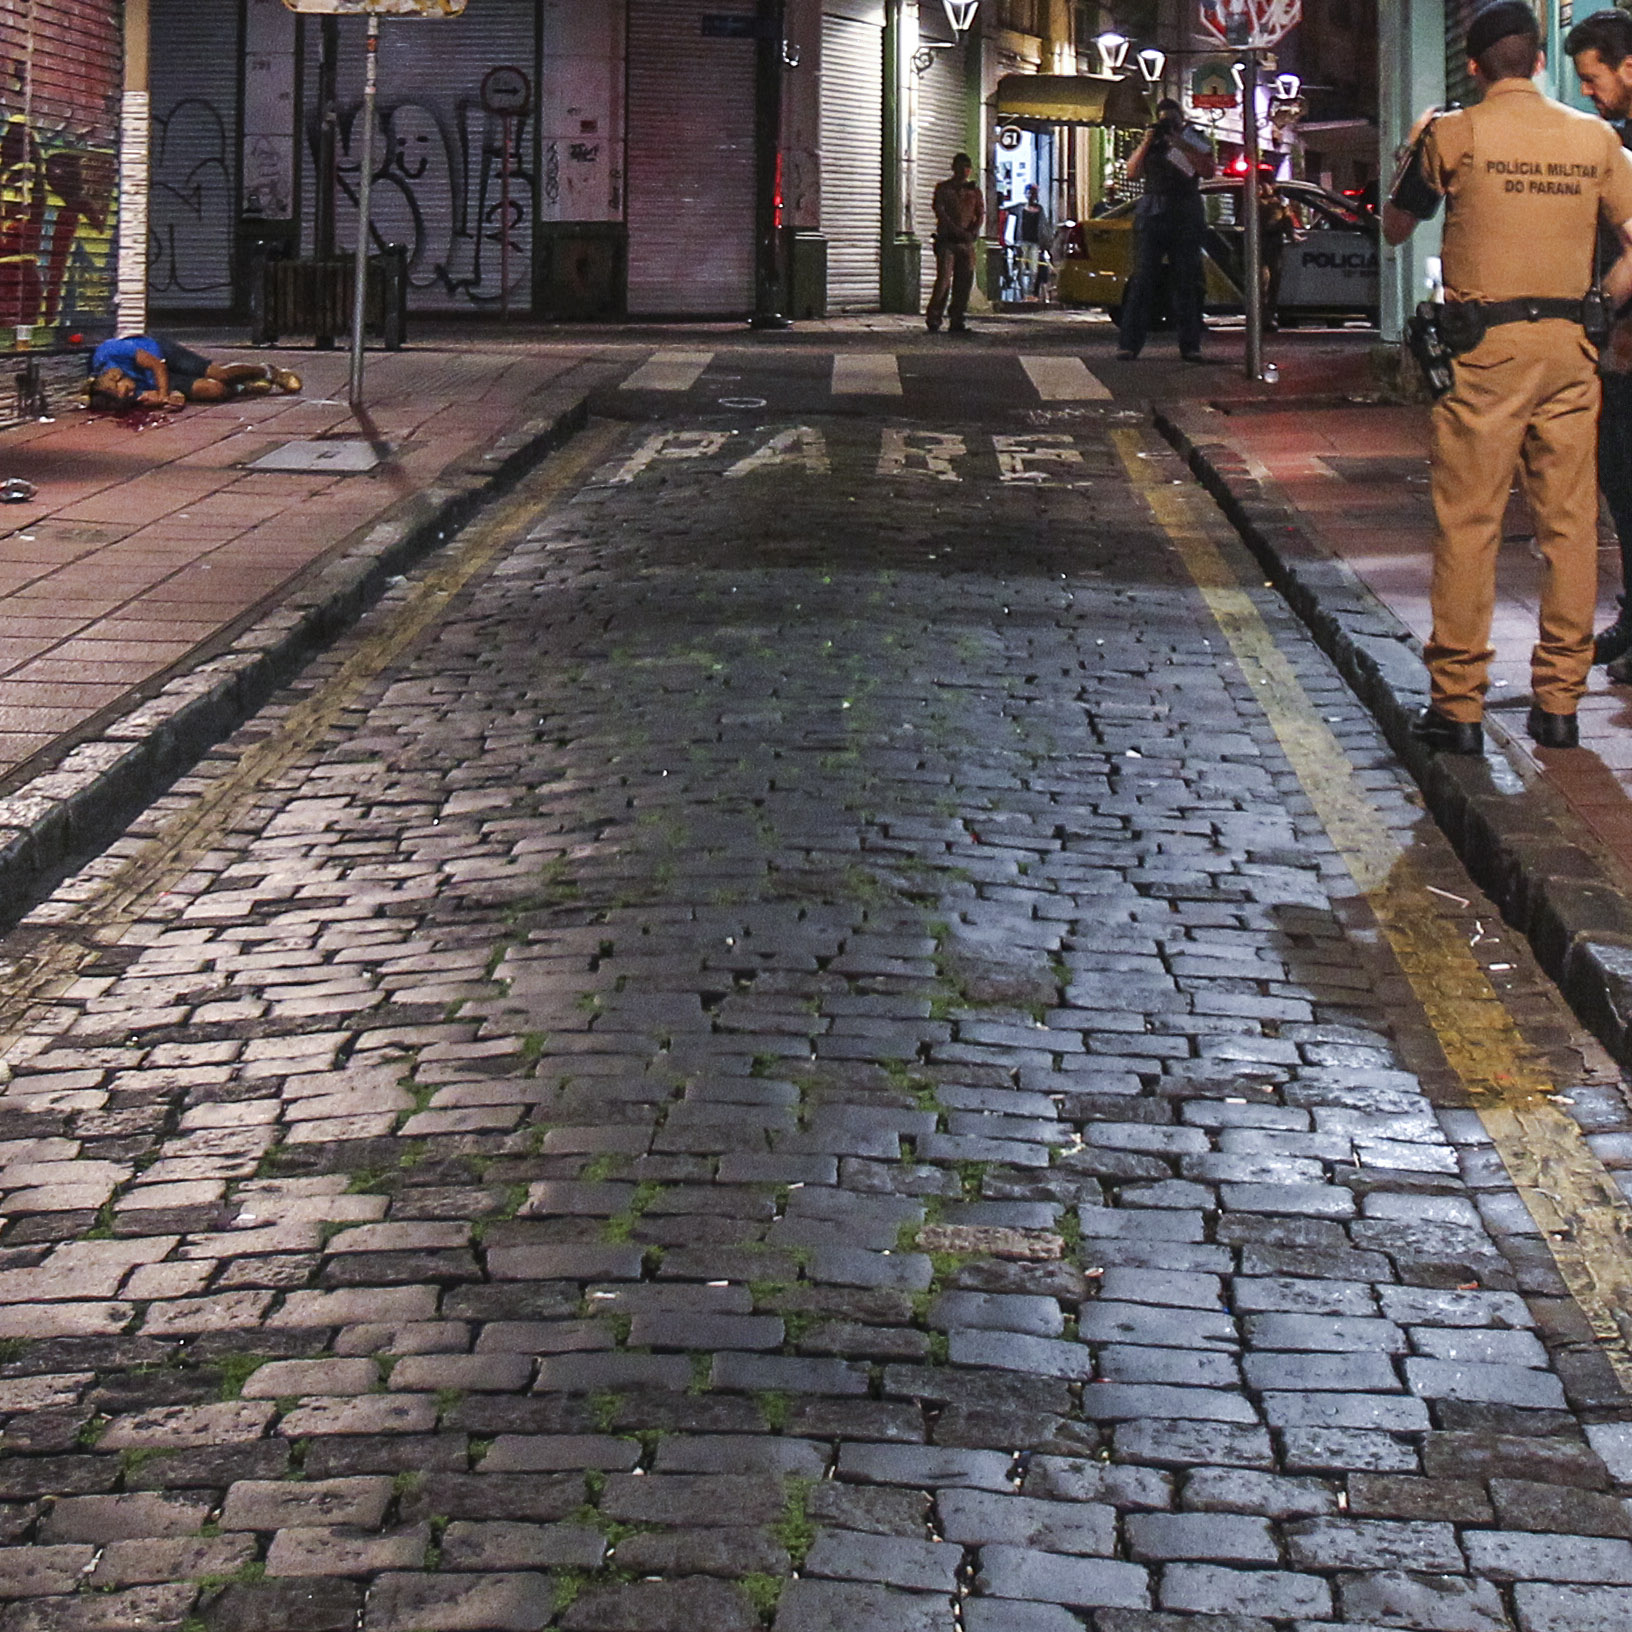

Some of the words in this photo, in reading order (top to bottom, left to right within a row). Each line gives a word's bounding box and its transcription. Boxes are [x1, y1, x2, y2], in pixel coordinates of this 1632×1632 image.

[1487, 157, 1543, 175] POLÍCIA
[1548, 162, 1598, 179] MILITAR
[1505, 180, 1525, 193] DO
[1528, 178, 1581, 196] PARANÁ
